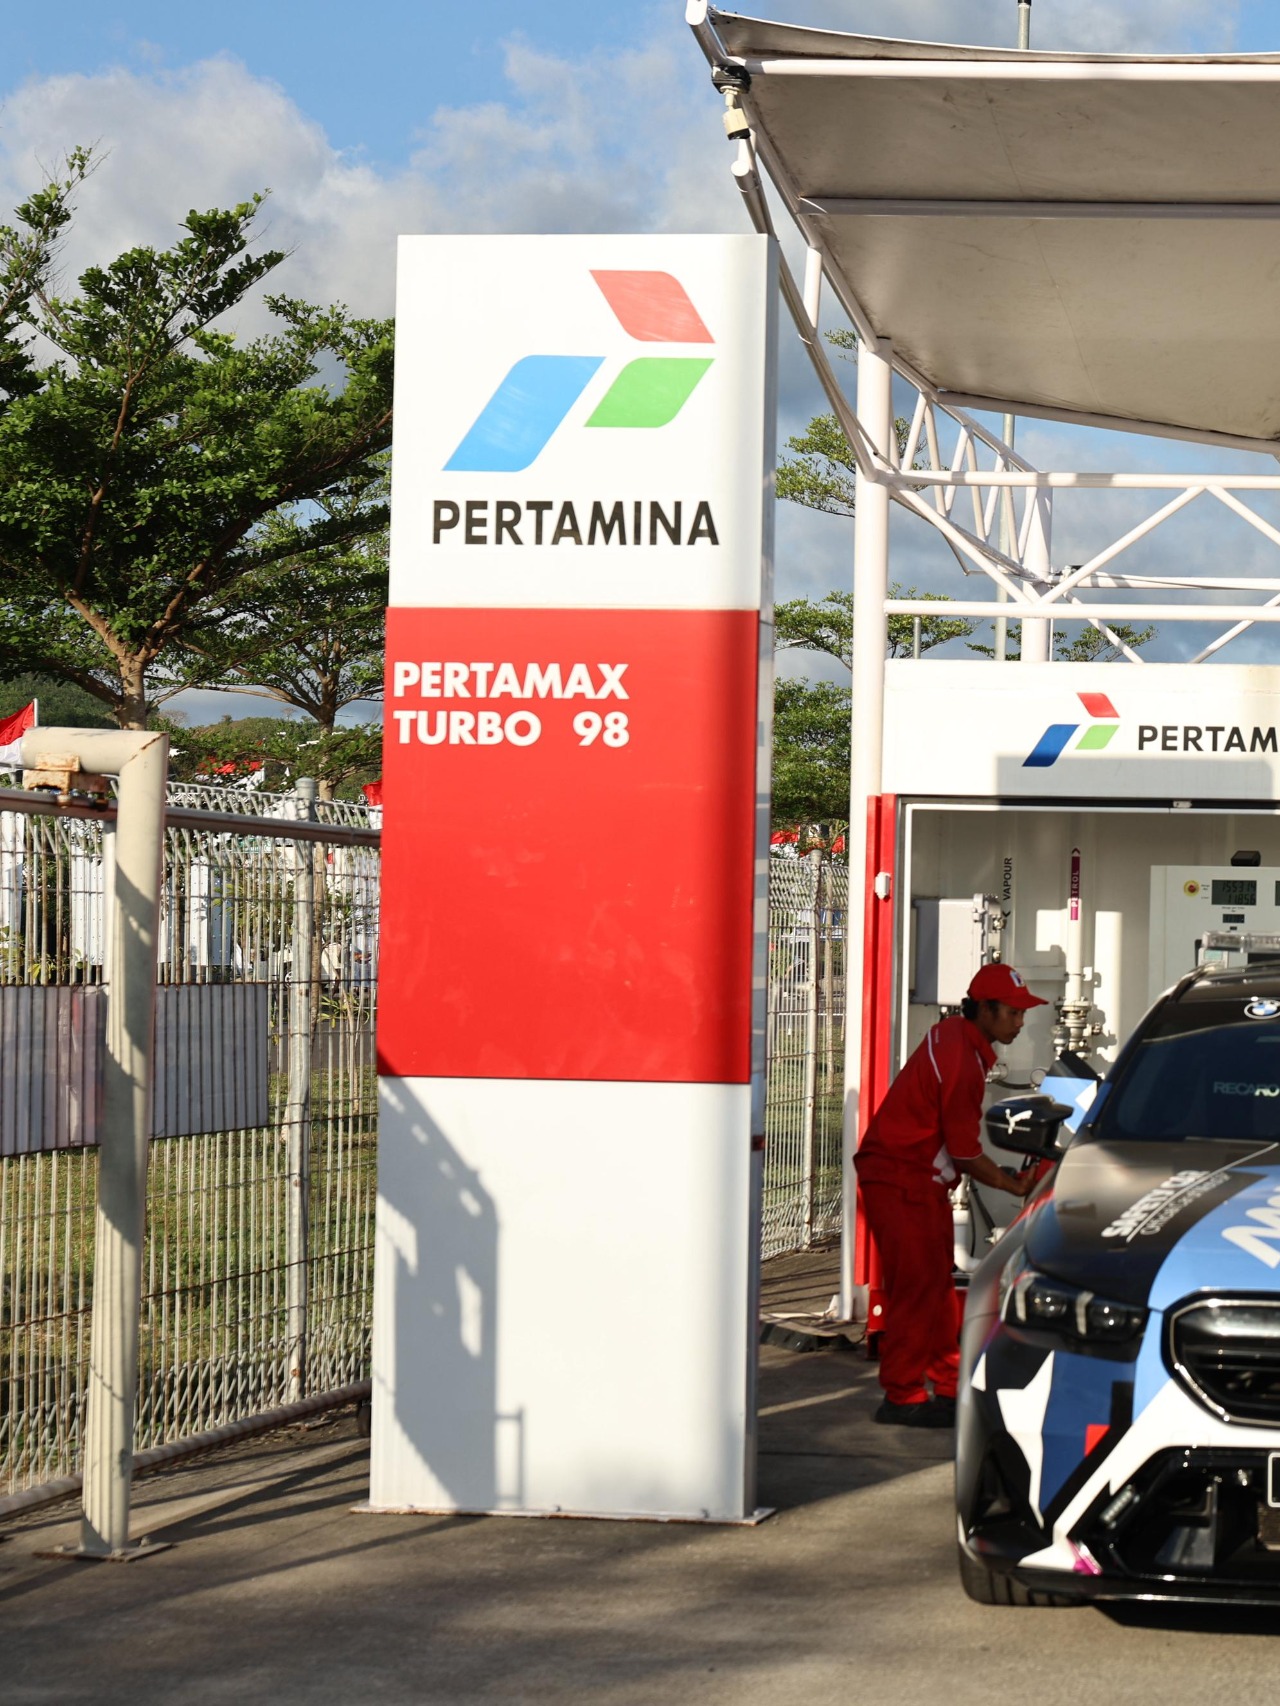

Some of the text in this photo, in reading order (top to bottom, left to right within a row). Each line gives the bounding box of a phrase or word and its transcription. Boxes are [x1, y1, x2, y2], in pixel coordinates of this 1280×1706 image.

[432, 500, 720, 546] PERTAMINA
[393, 661, 630, 700] PERTAMAX
[393, 709, 630, 748] TURBO 98
[1003, 857, 1013, 900] VAPOUR
[1070, 870, 1080, 908] PETROL
[1213, 1081, 1280, 1098] RECARO
